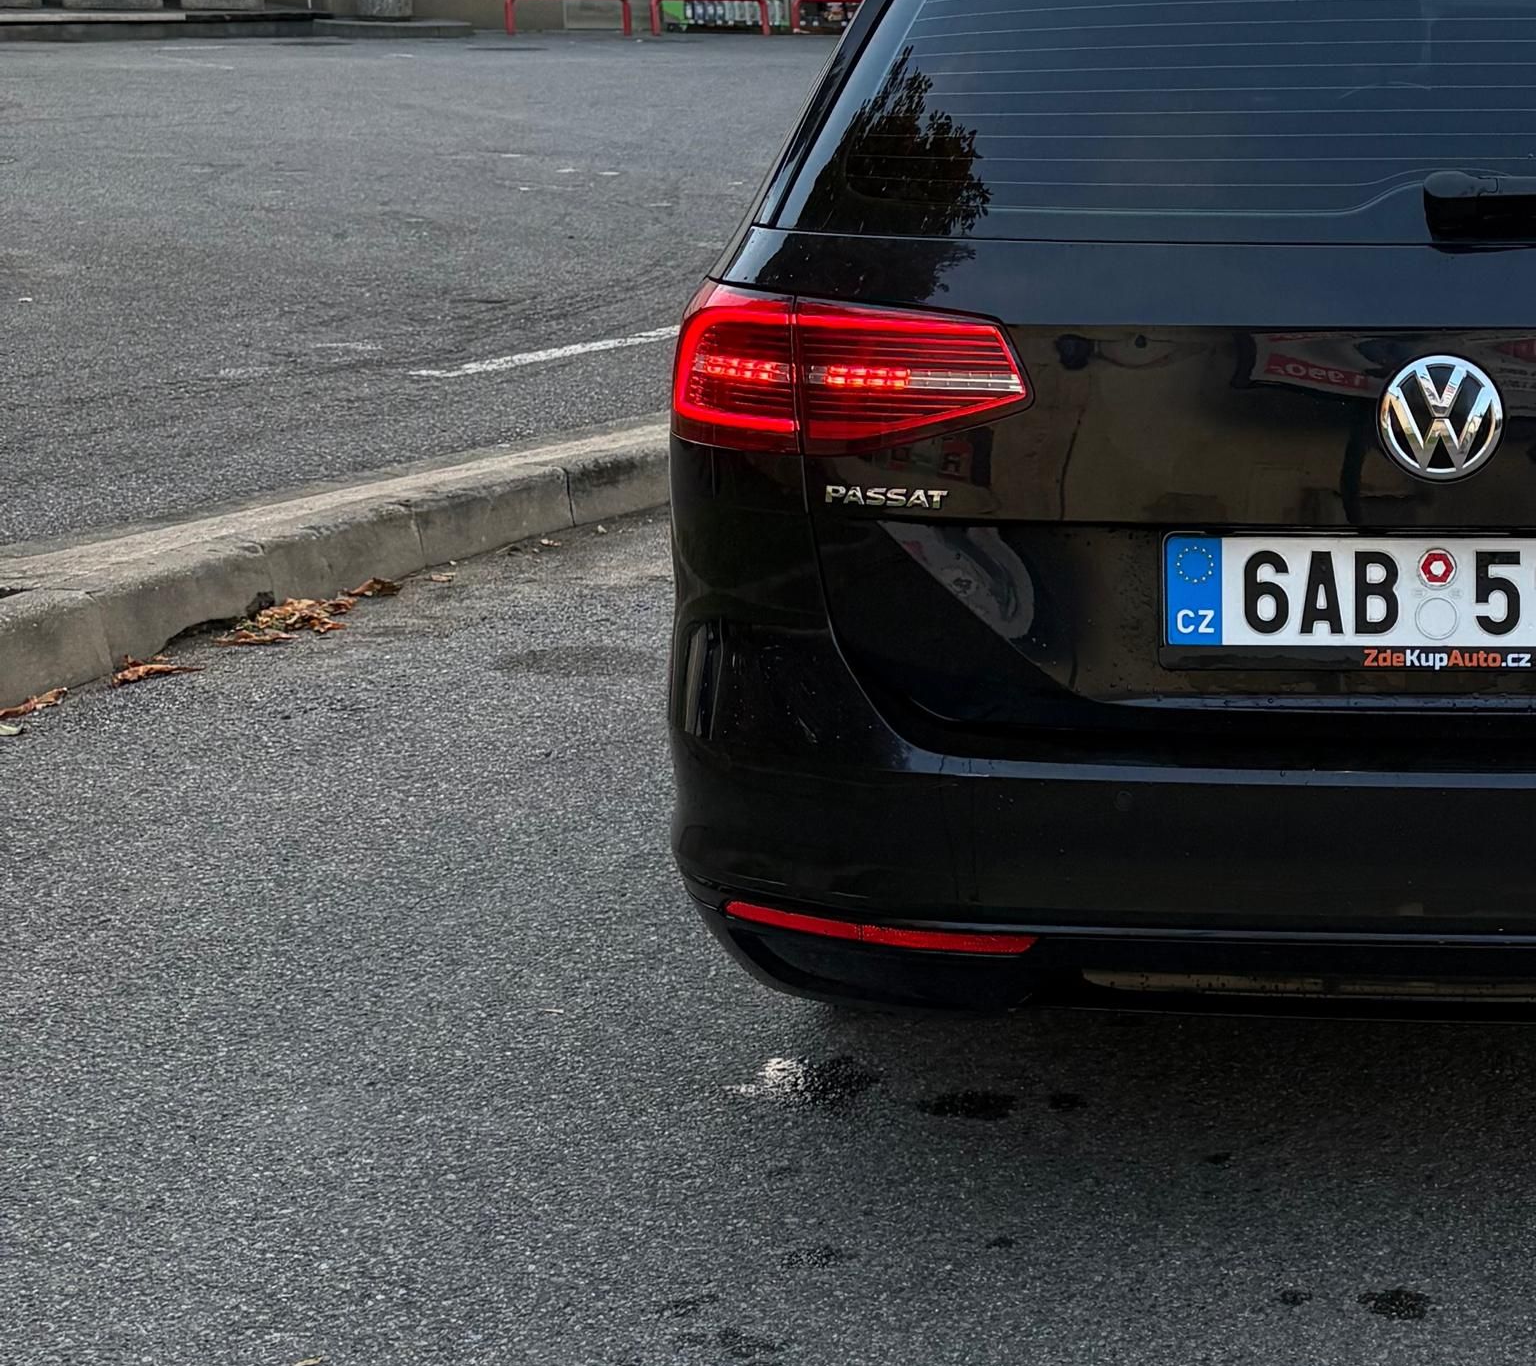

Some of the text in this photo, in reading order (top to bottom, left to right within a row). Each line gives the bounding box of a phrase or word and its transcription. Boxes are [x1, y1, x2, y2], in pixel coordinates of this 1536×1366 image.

[825, 484, 949, 509] PASSAT
[1176, 608, 1215, 635] CZ
[1243, 550, 1400, 635] 6AB
[1363, 648, 1532, 671] ZdeKupAuto.cz
